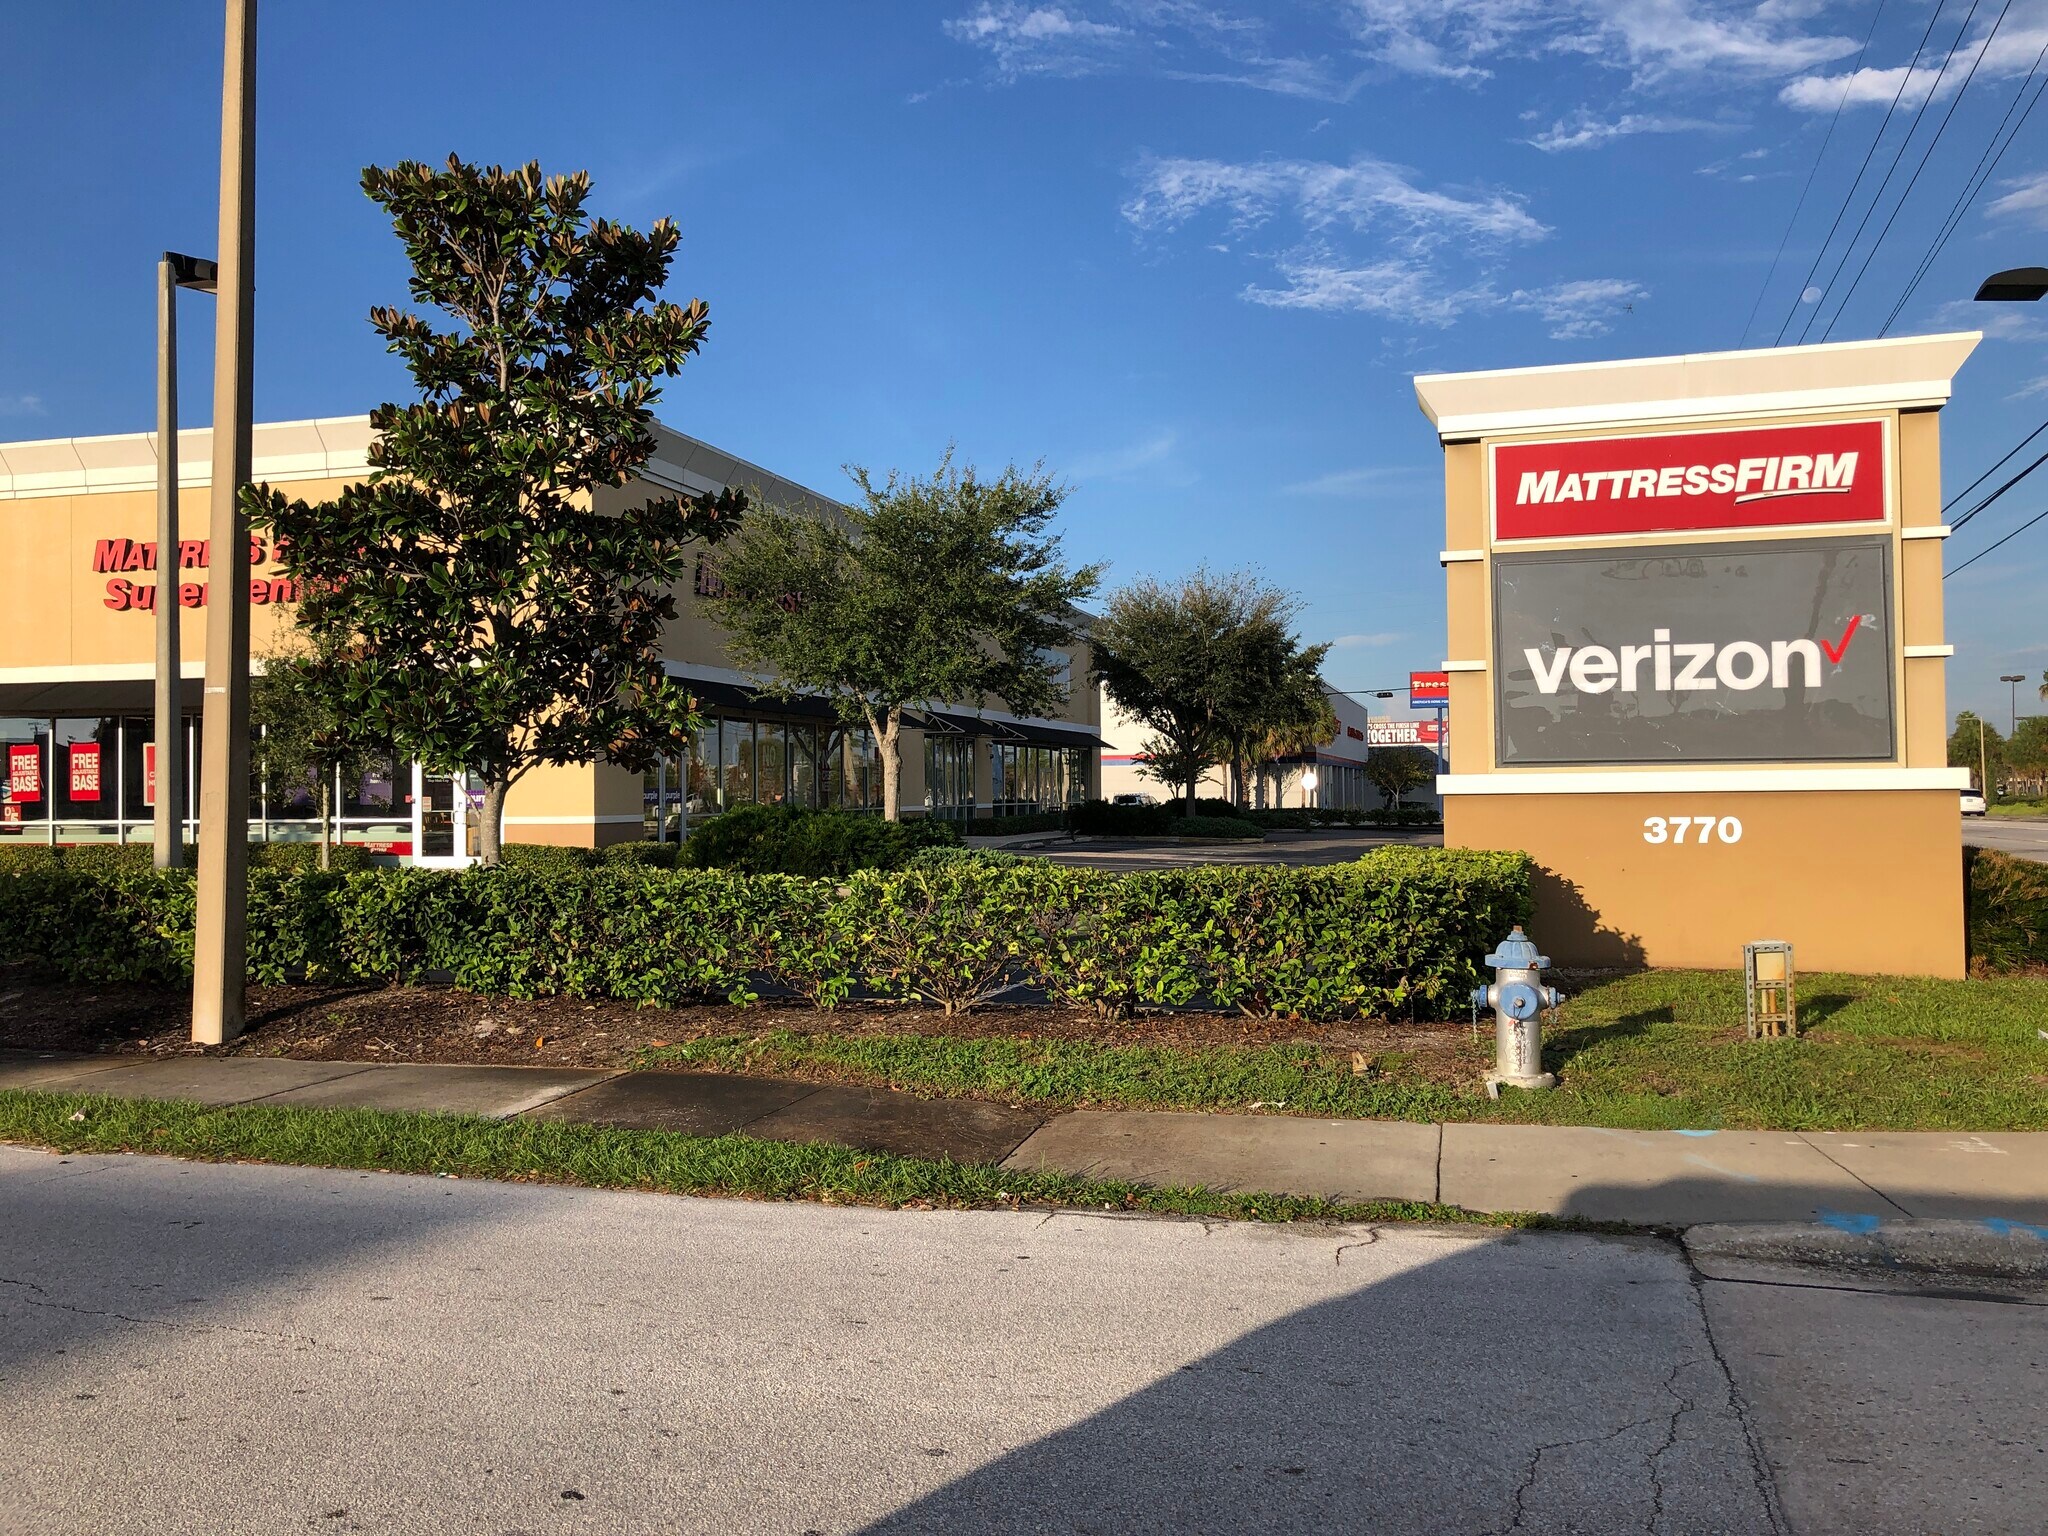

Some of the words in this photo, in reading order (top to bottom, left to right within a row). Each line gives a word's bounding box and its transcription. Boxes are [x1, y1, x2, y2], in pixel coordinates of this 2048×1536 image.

[1524, 628, 1821, 694] verizon
[12, 754, 38, 770] FREE
[72, 753, 98, 768] FREE
[12, 775, 38, 792] BASE
[72, 774, 98, 791] BASE
[666, 791, 681, 801] purple
[1643, 816, 1743, 844] 3770
